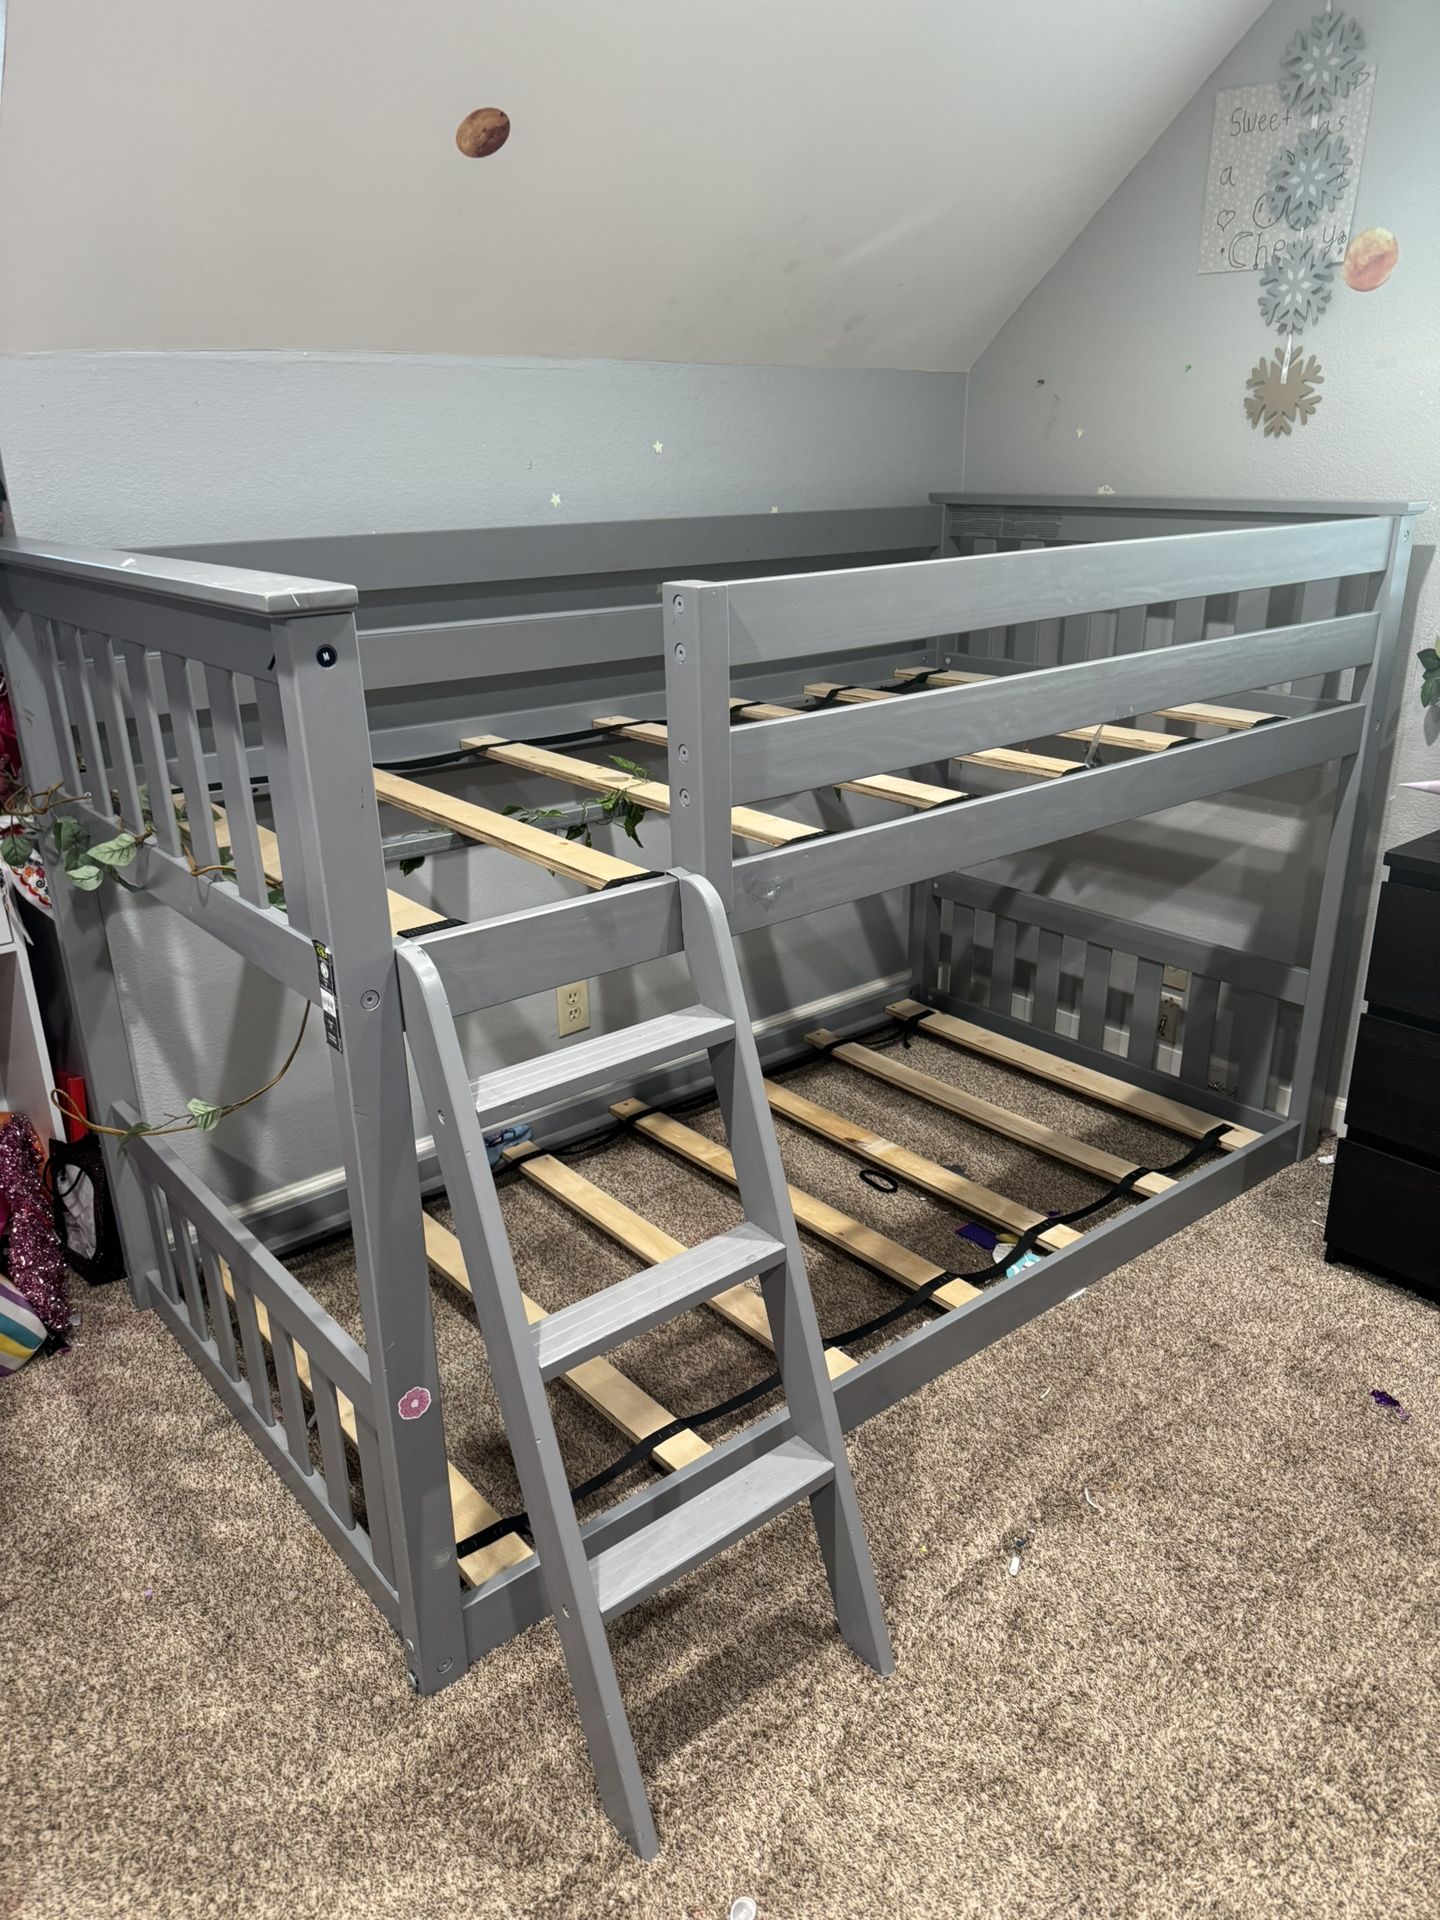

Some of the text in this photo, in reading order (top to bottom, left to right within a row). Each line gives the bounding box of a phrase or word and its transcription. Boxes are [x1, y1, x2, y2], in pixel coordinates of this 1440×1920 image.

[1229, 107, 1293, 137] Sweet
[1219, 165, 1236, 187] a
[1228, 225, 1347, 270] Chey
